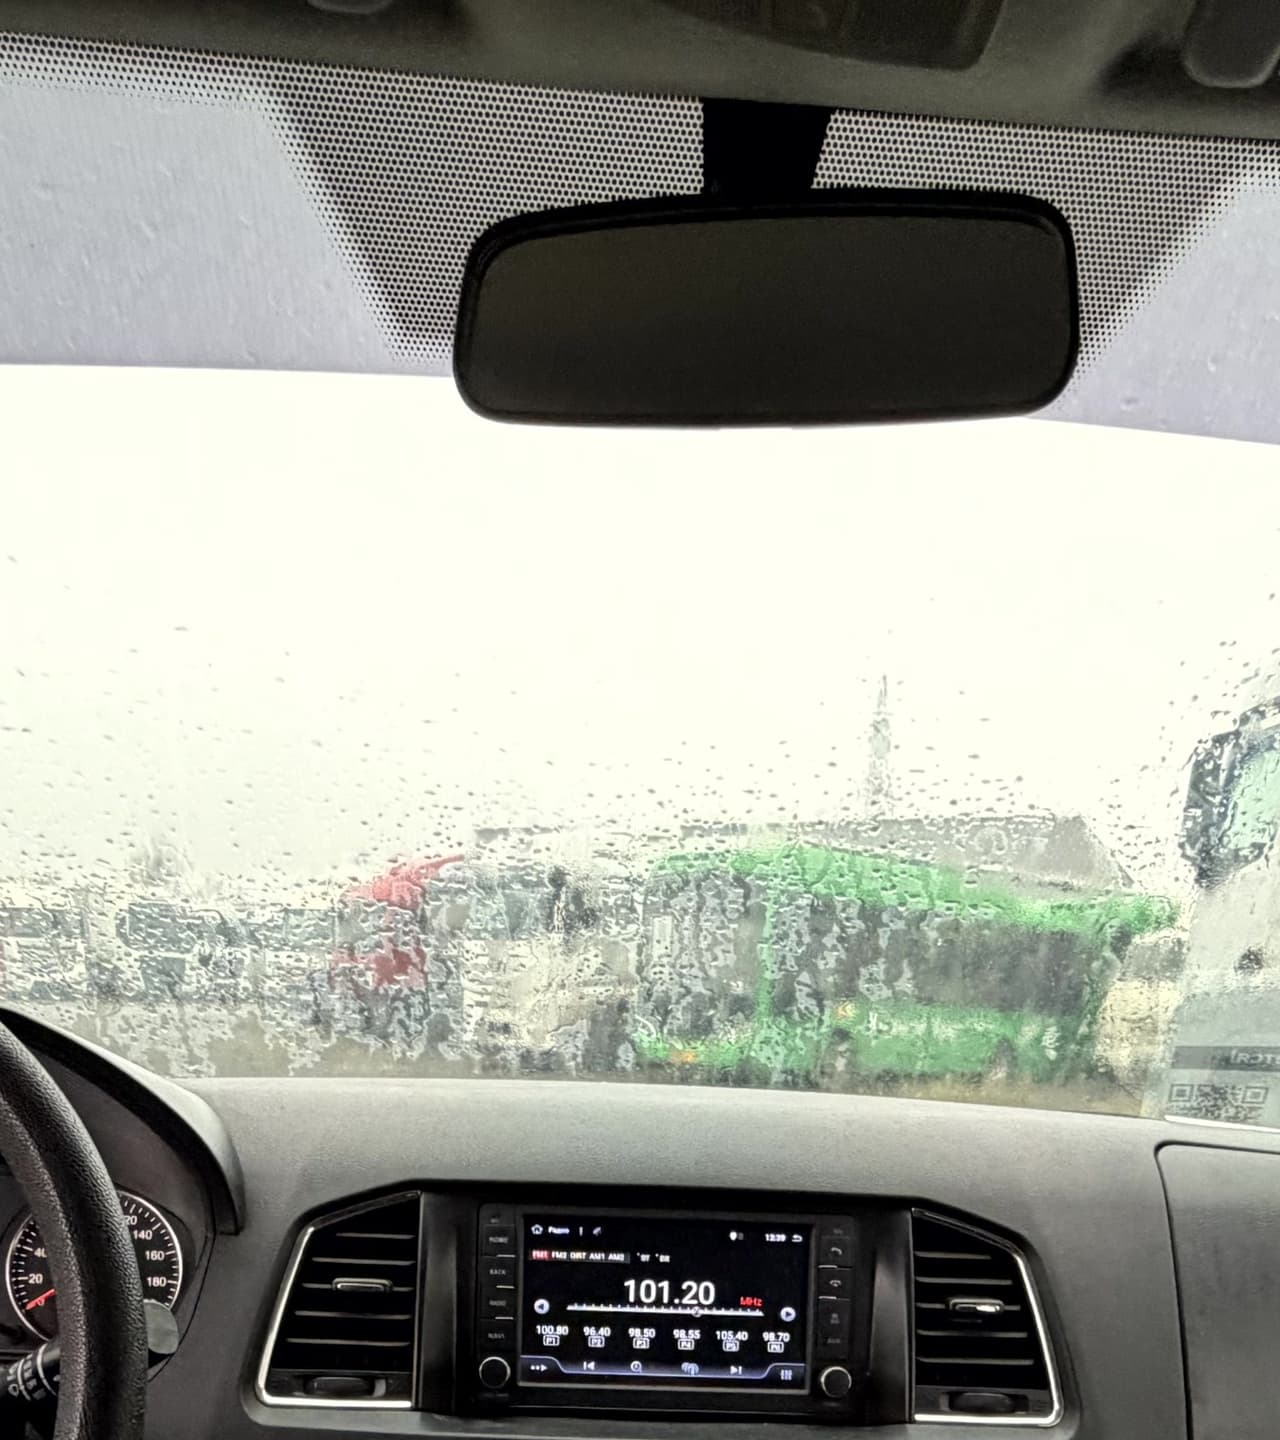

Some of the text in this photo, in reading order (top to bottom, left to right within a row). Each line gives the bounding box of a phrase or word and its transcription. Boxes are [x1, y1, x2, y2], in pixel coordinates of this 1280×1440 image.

[122, 1215, 138, 1226] 20
[132, 1229, 153, 1241] 140
[144, 1251, 165, 1261] 160
[28, 1273, 44, 1285] 20
[146, 1276, 167, 1288] 180
[623, 1279, 716, 1306] 101.20
[535, 1324, 569, 1336] 100.80
[583, 1325, 612, 1338] 96.40
[628, 1327, 656, 1339] 98.50
[673, 1328, 701, 1340] 98.55
[715, 1330, 749, 1342] 105.40
[762, 1331, 791, 1343] 98.70
